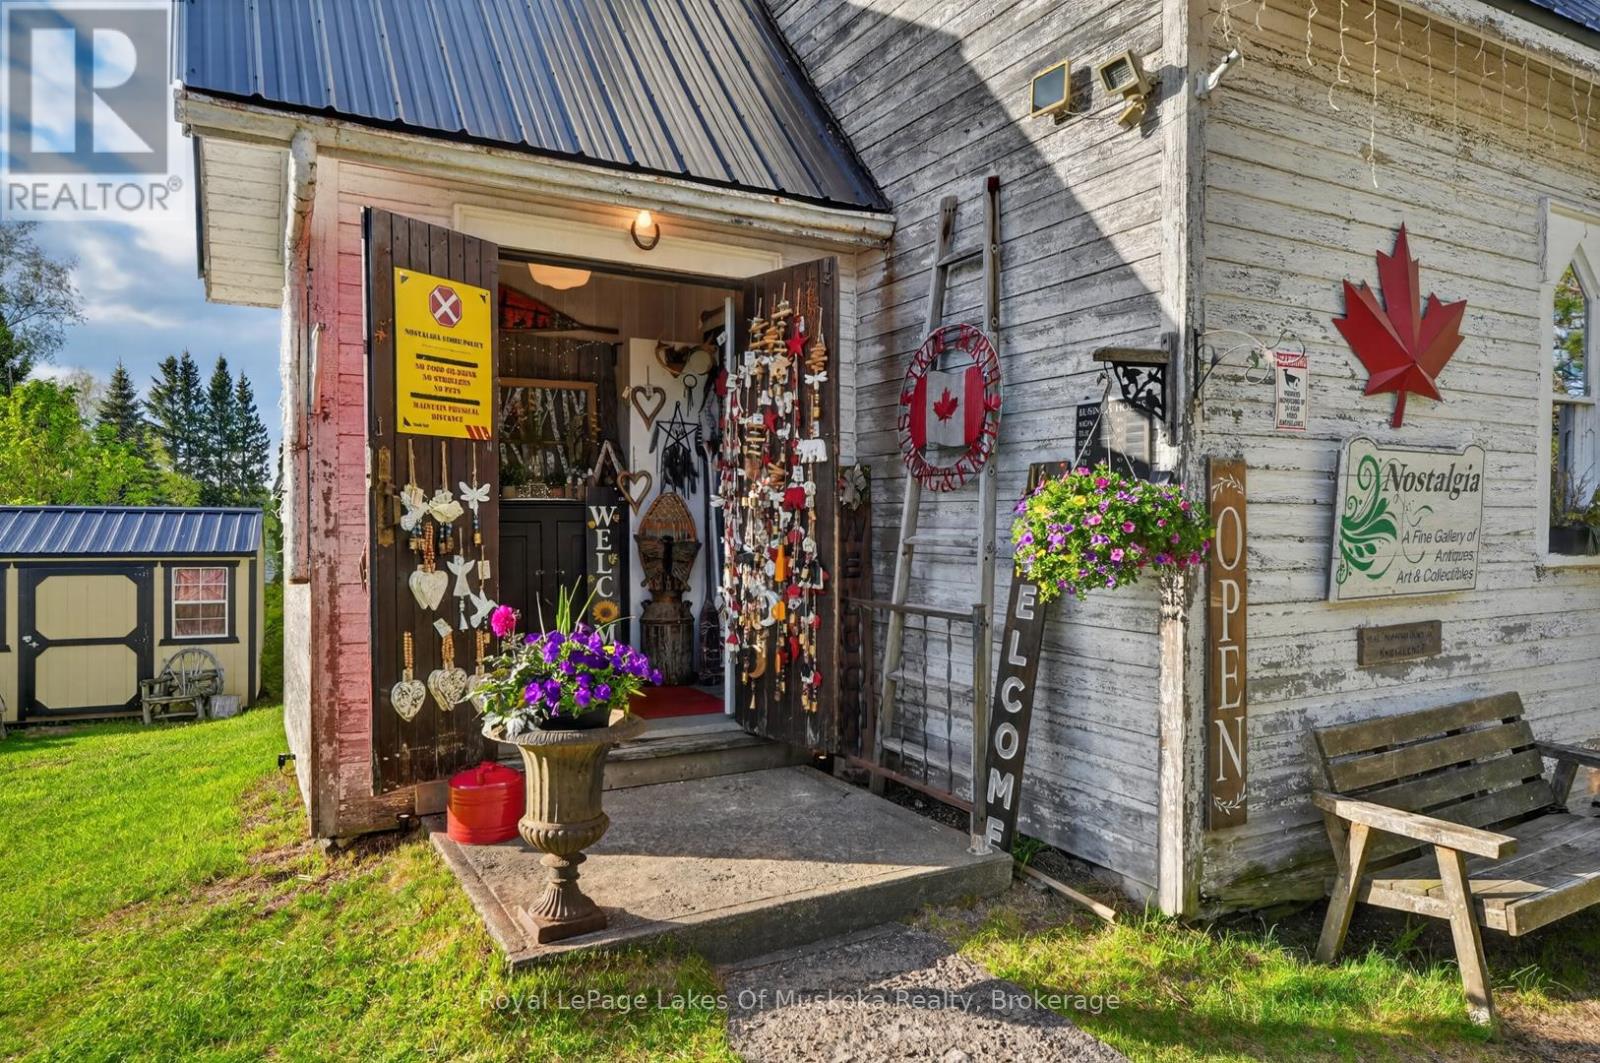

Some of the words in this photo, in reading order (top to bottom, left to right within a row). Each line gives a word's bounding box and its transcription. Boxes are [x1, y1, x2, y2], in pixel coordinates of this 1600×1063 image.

[1382, 463, 1480, 500] Nostalgia
[1402, 531, 1410, 544] A
[1411, 530, 1433, 544] Fine
[1434, 529, 1466, 545] Gallery
[1466, 528, 1477, 542] of
[1396, 571, 1412, 584] Art
[1413, 570, 1421, 583] &
[1423, 568, 1474, 583] Collectibles
[1215, 506, 1245, 782] OPEN
[986, 584, 1037, 848] ELCOME
